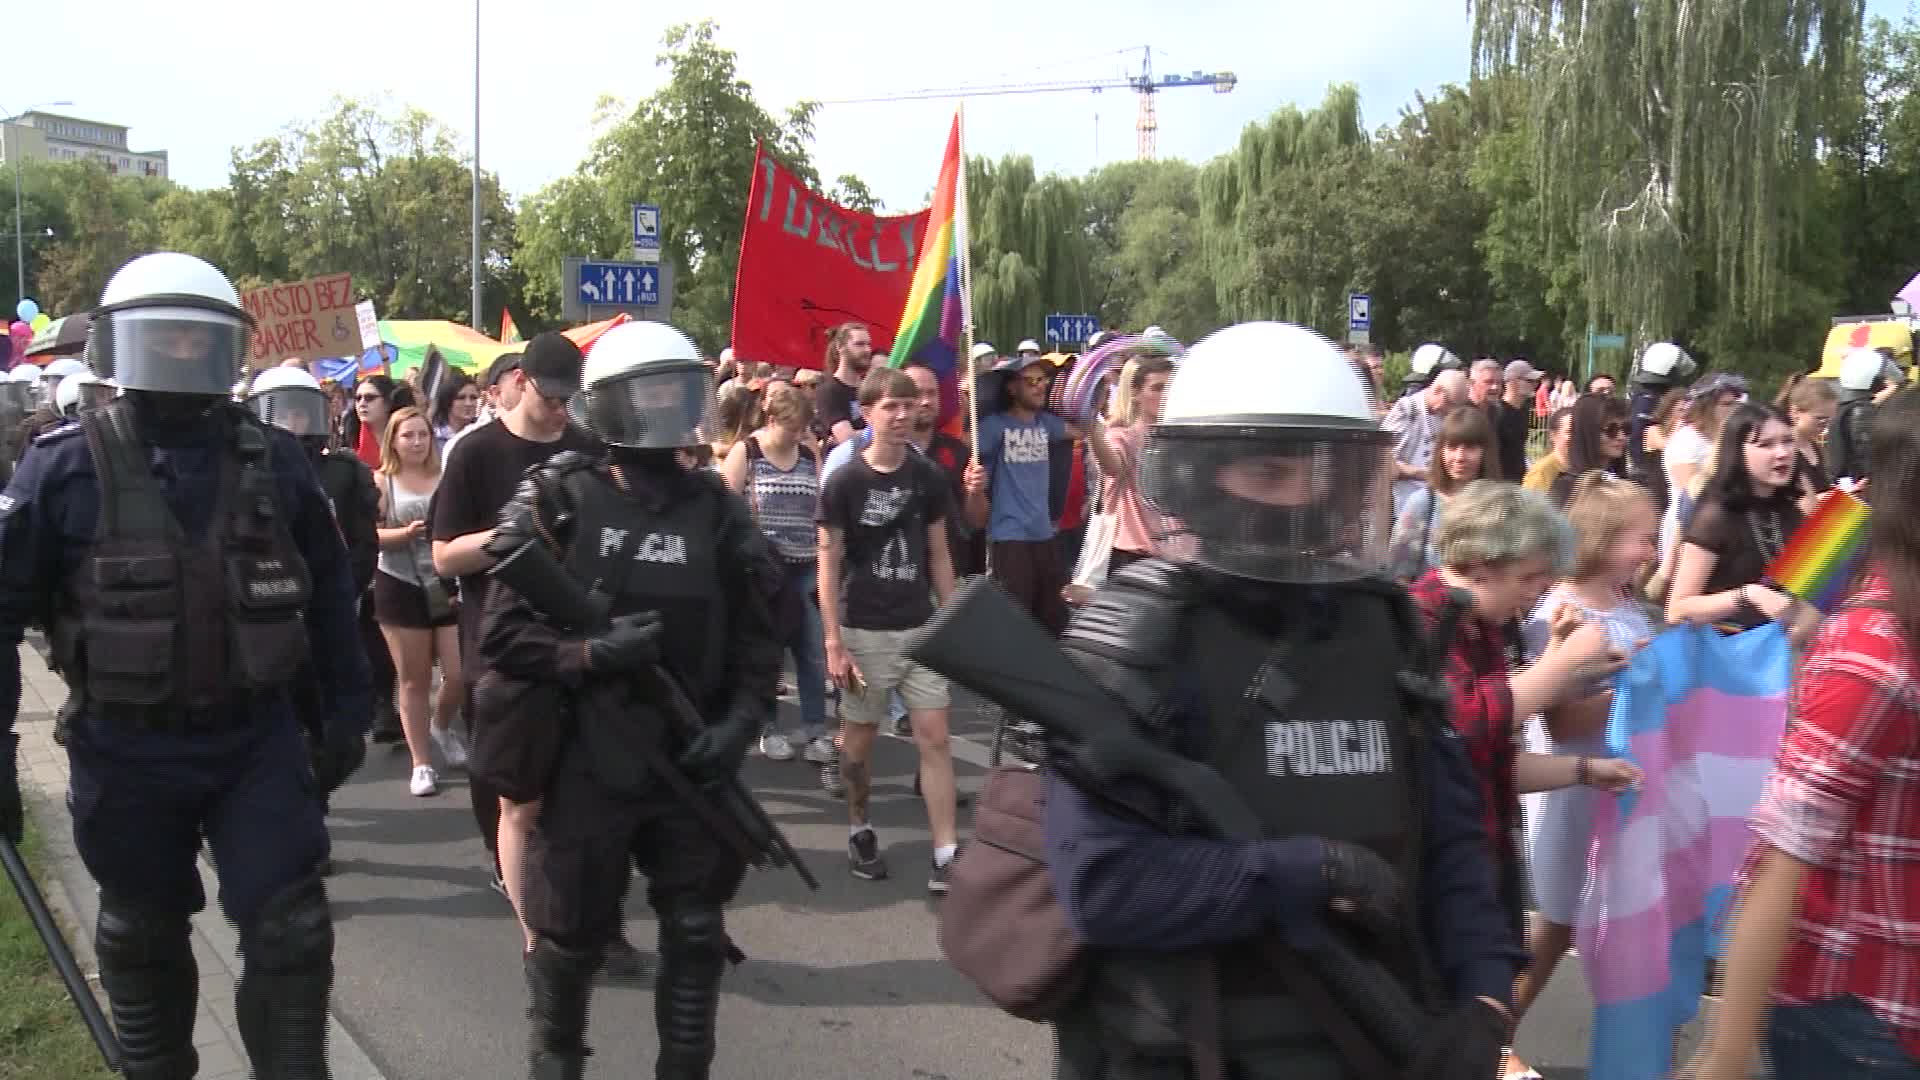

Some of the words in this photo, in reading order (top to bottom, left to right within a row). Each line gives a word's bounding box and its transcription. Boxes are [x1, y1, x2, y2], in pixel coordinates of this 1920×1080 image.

[314, 277, 355, 311] BEZ
[254, 319, 322, 360] BARIER
[249, 578, 299, 597] POLICJA
[1264, 719, 1393, 776] POLICJA
